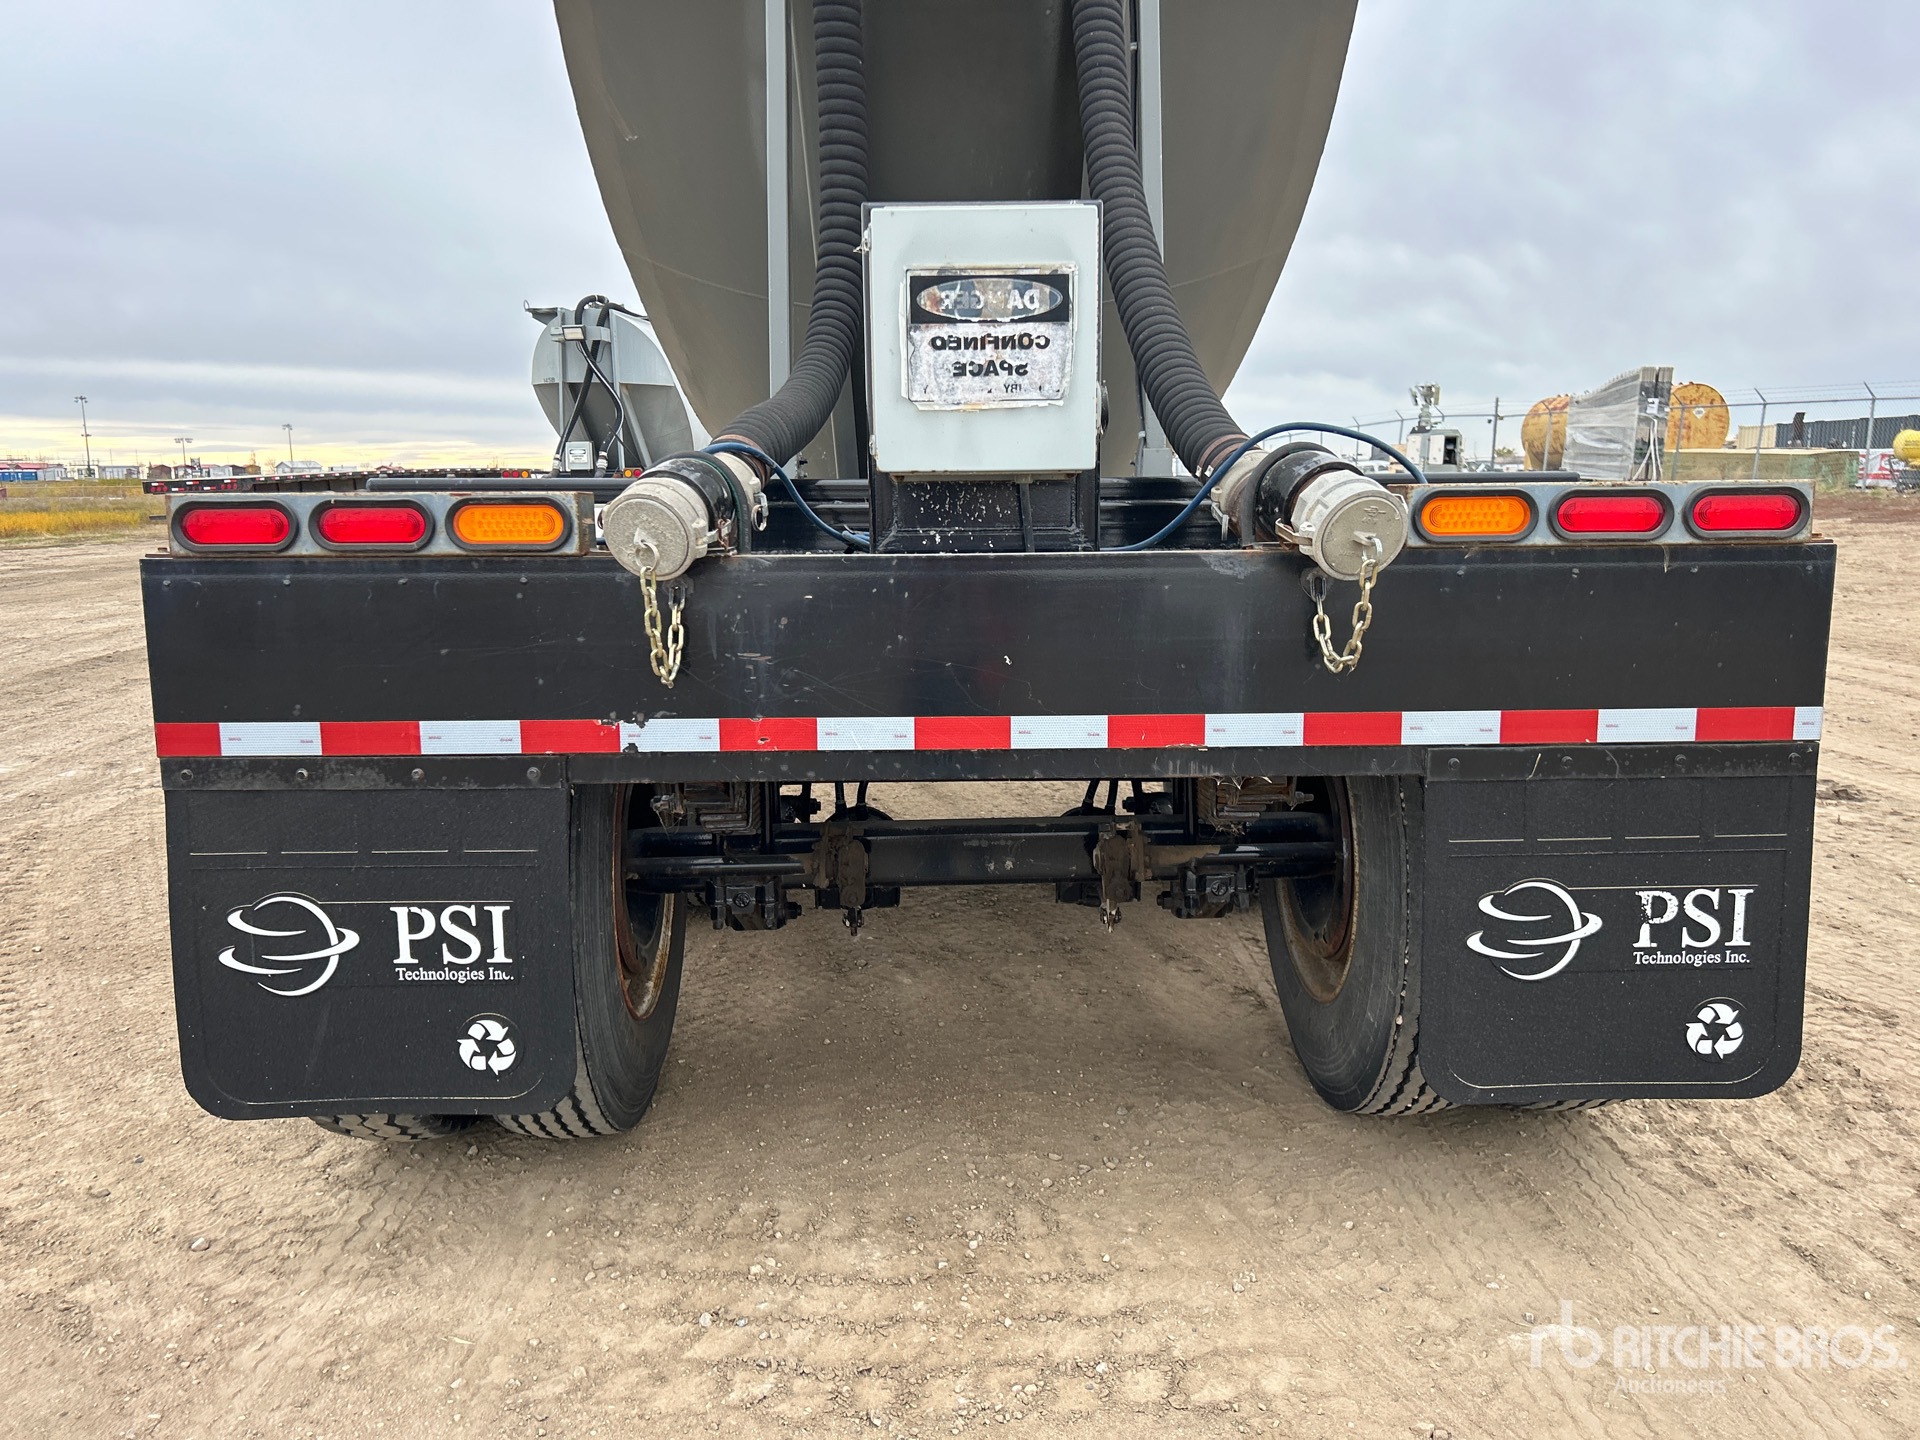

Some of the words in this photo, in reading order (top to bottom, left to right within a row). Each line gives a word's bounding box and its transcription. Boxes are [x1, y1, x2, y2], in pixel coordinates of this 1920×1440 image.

[390, 905, 513, 965] PSI
[1632, 888, 1754, 948] PSI
[395, 967, 485, 984] Technologies
[1633, 951, 1721, 968] Technologies
[1725, 951, 1751, 964] Inc.
